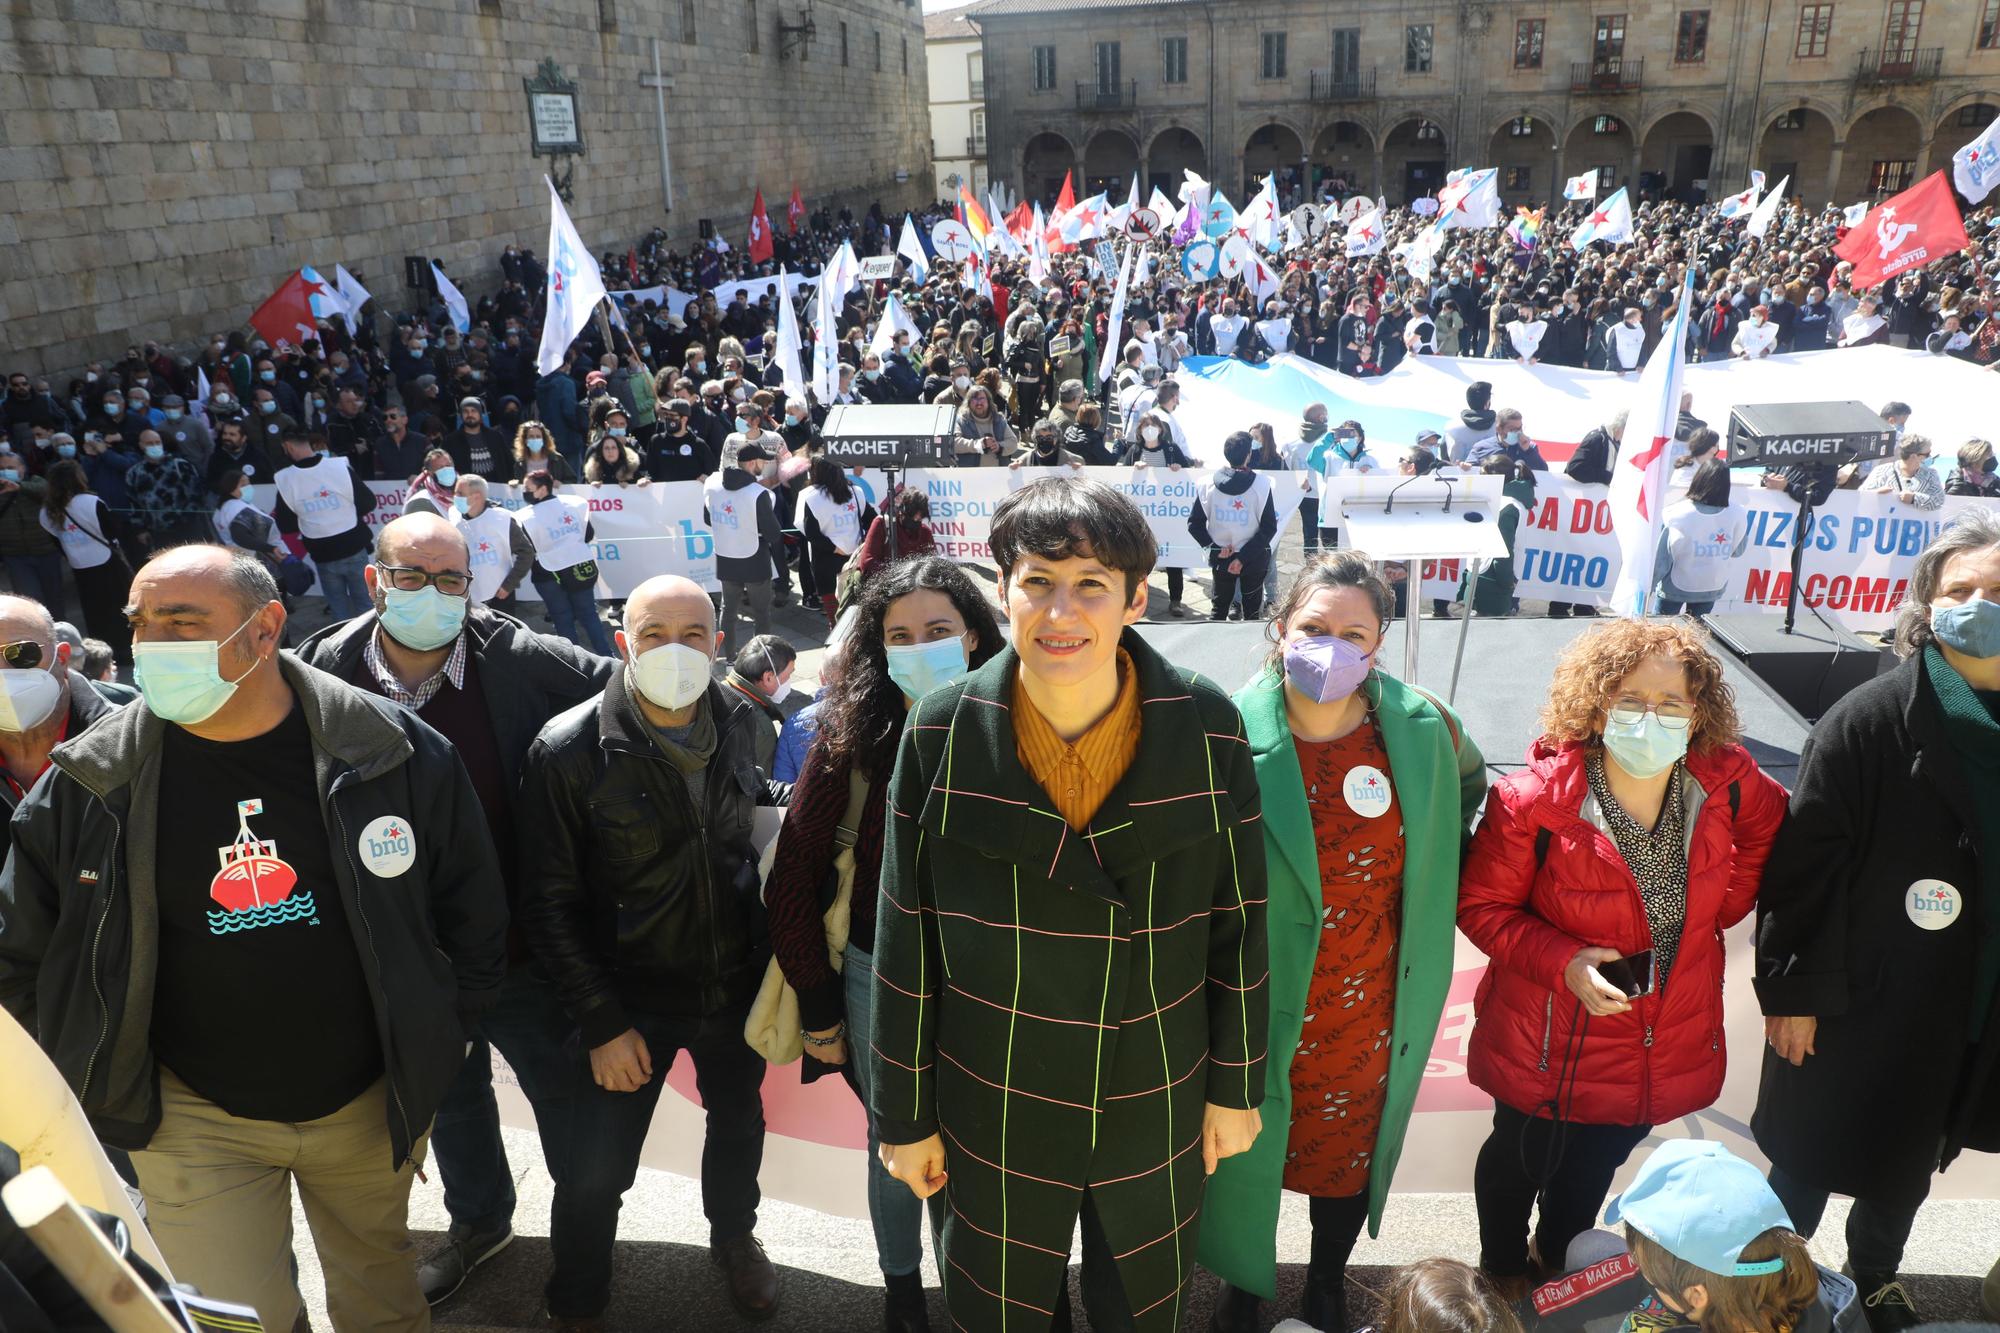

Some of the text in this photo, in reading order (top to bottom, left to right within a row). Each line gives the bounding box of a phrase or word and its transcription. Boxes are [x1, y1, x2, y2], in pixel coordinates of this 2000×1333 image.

[827, 440, 899, 455] KACHET
[1765, 438, 1844, 456] KACHET
[928, 480, 962, 497] NIN
[1215, 505, 1249, 528] bng
[931, 522, 965, 537] NIN
[1693, 538, 1732, 561] bng
[1522, 548, 1609, 588] TURO
[1350, 784, 1386, 804] bng
[368, 836, 409, 858] bng
[1913, 892, 1953, 915] bng
[1585, 1259, 1622, 1286] MAKER
